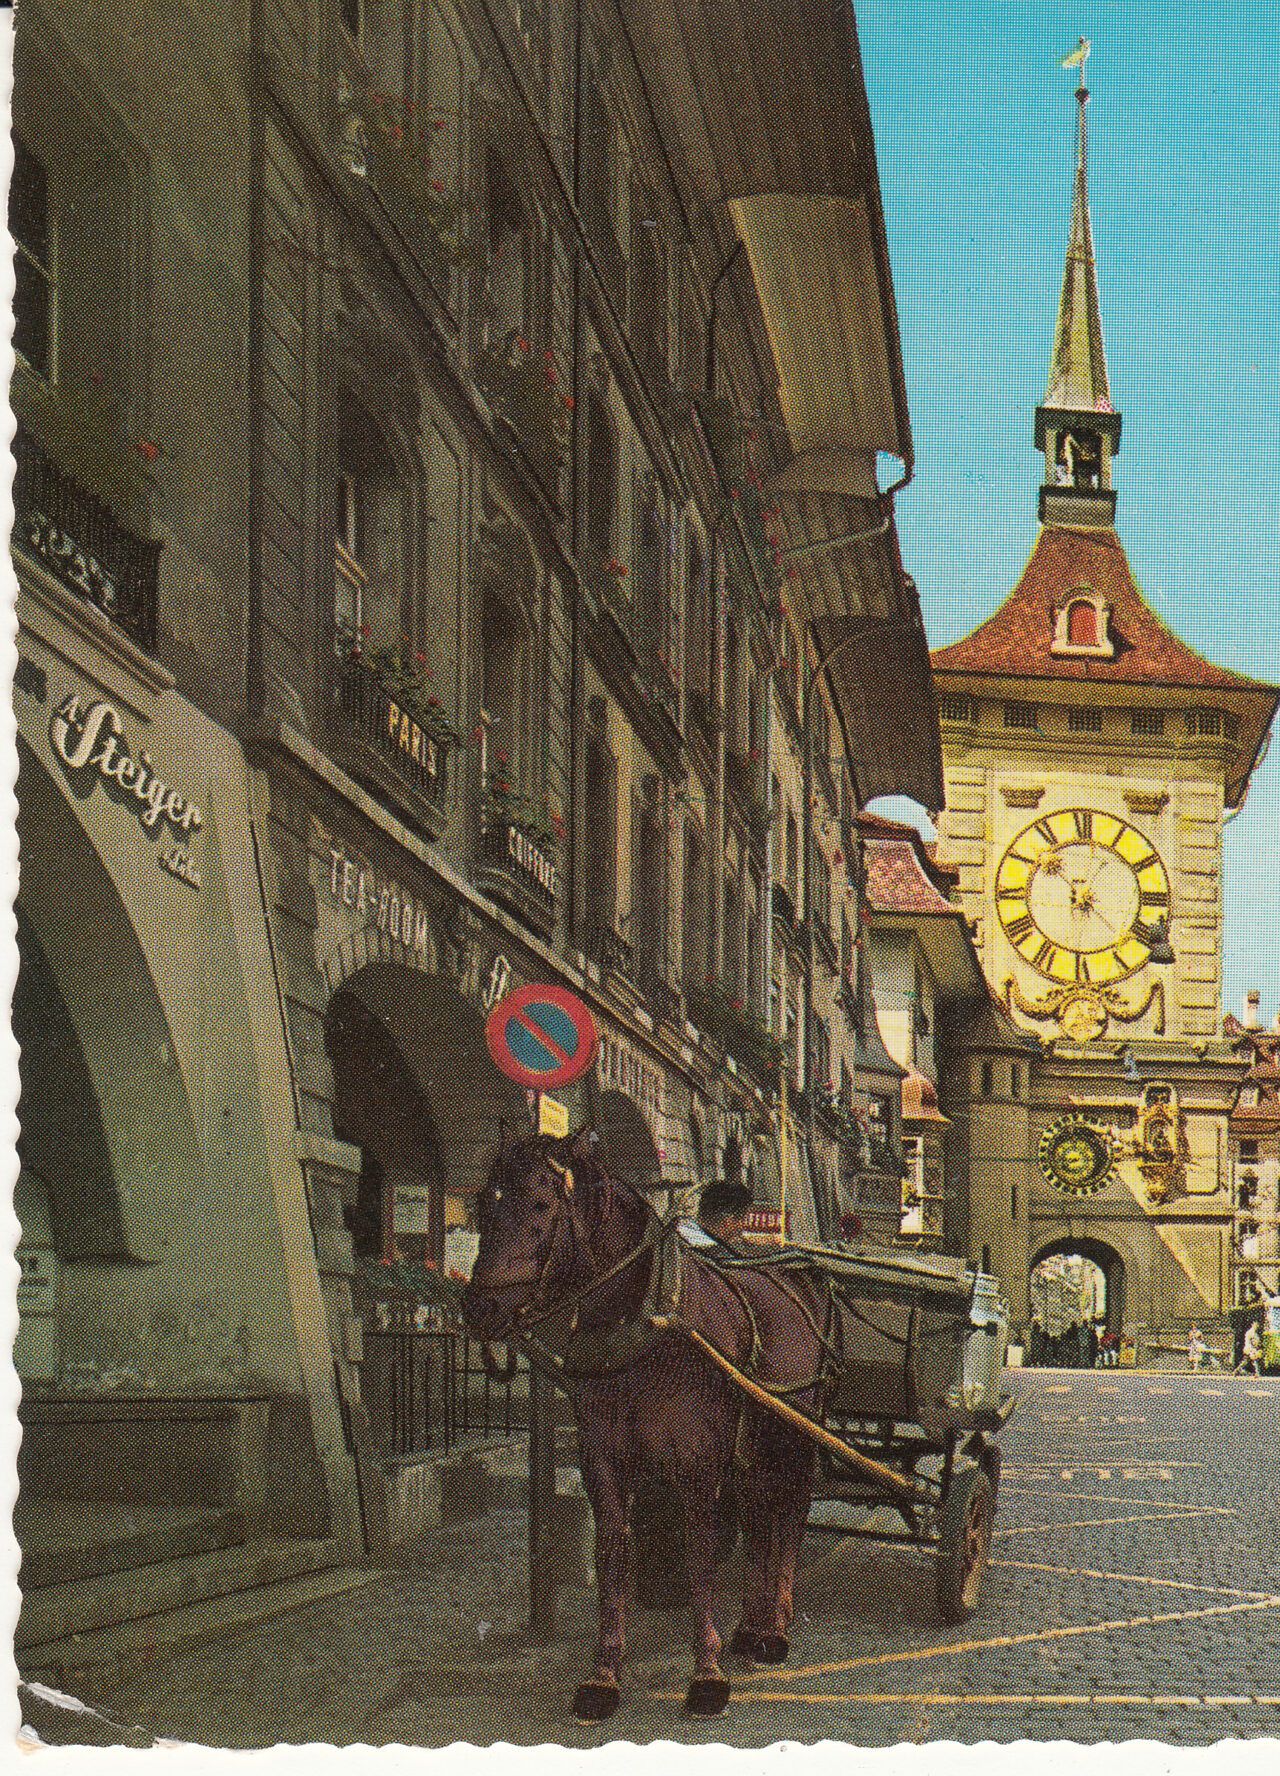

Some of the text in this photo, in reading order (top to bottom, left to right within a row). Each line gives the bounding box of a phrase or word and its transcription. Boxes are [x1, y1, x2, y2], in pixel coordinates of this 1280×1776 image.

[53, 702, 202, 829] Steiger
[388, 700, 438, 777] PARIS
[330, 848, 428, 955] TEA-ROOM
